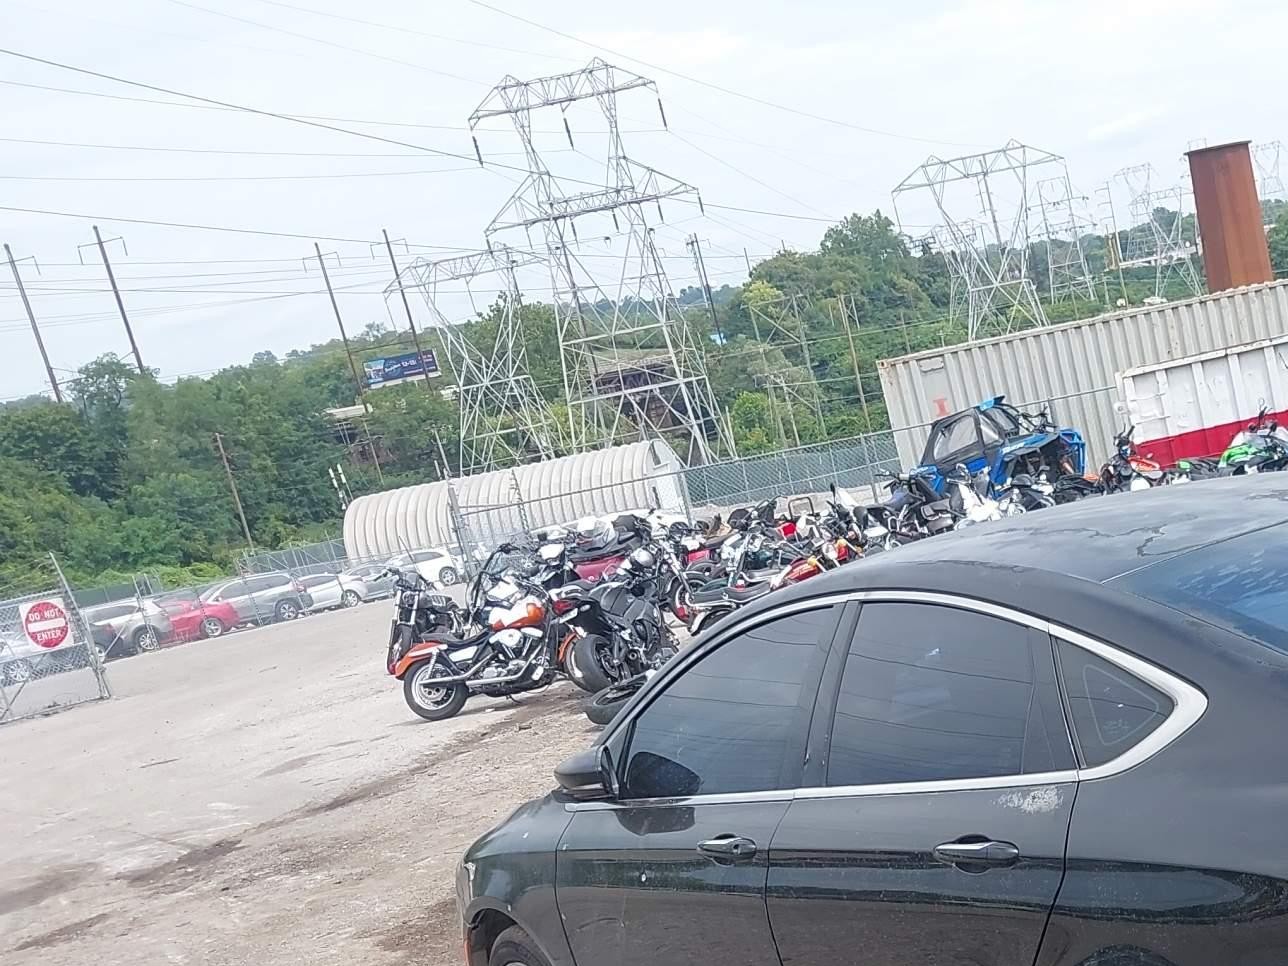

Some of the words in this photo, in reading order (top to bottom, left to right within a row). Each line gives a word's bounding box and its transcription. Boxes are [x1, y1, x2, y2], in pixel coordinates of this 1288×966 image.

[29, 613, 40, 622] DO
[44, 609, 60, 618] NOT
[37, 630, 63, 641] ENTER
